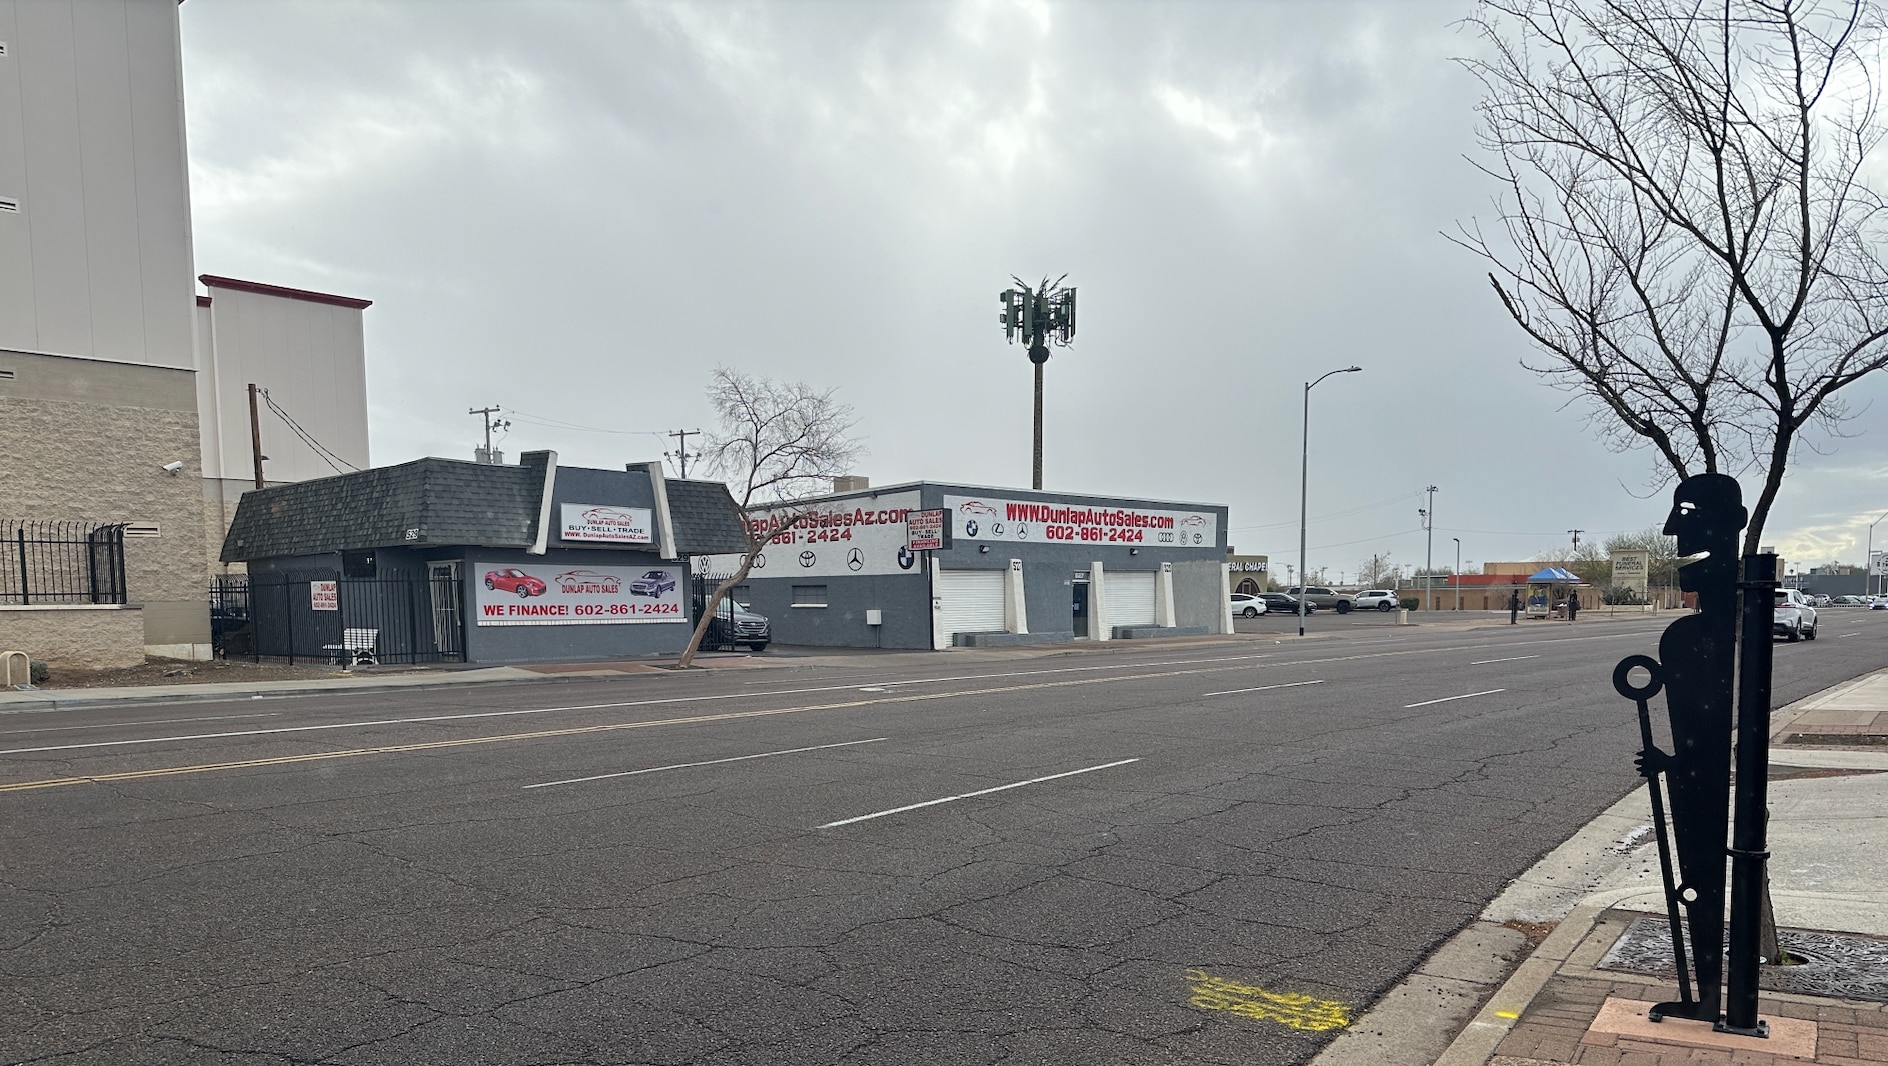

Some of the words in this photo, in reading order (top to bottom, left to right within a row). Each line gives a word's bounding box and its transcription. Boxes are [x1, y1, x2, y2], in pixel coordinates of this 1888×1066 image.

[1006, 503, 1174, 529] WWW.DunlapAutoSales.com
[1046, 525, 1143, 542] 602-861-2424
[1245, 562, 1268, 571] CHAPEL
[562, 584, 584, 593] DUNLAP
[585, 585, 600, 593] AUTO
[601, 585, 618, 593] SALES
[484, 605, 504, 616] WE
[509, 605, 569, 616] FINANCE!
[575, 603, 679, 615] 602-861-2424
